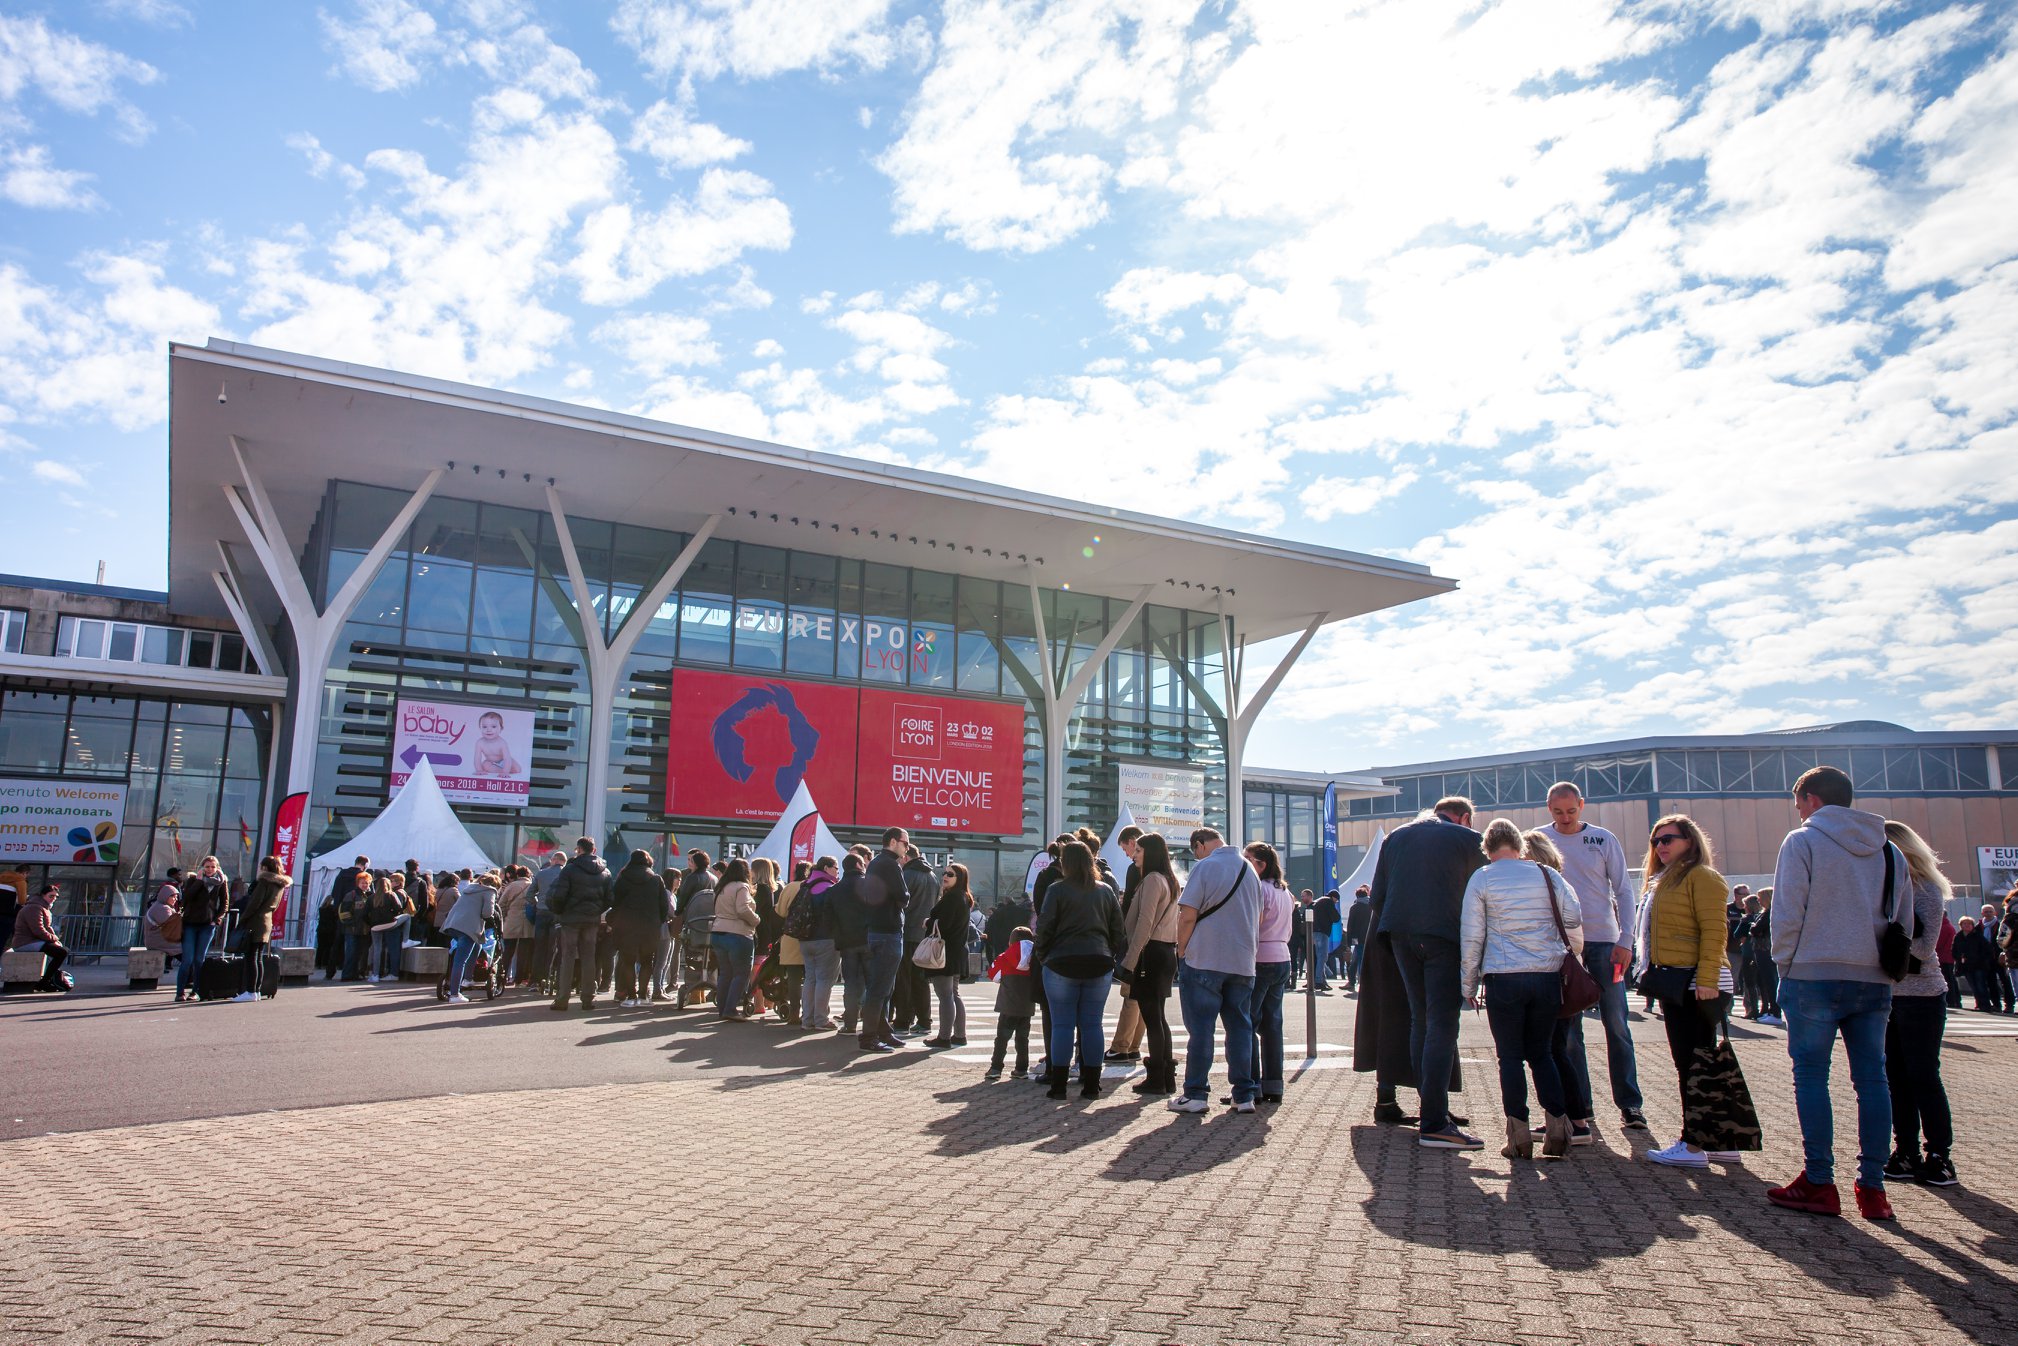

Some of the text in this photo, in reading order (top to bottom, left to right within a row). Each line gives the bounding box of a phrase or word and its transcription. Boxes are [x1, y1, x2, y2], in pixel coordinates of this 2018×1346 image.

[740, 606, 905, 649] EUREXPO
[865, 647, 928, 673] LYON
[408, 705, 435, 715] LE SALON
[404, 713, 466, 745] baby
[901, 718, 934, 732] FOIRE
[947, 722, 993, 736] 23 02
[900, 732, 934, 746] LYON
[892, 764, 993, 789] BIENVENUE
[1121, 767, 1150, 779] Welkom
[457, 779, 477, 789] 2018
[486, 781, 502, 791] Hall
[504, 782, 515, 792] 2.1
[518, 783, 524, 792] C
[55, 787, 120, 800] Welcome
[891, 785, 993, 809] WELCOME
[24, 806, 113, 817] пожаловать
[1164, 805, 1200, 816] Bienvenido
[1583, 835, 1605, 846] RAW
[1992, 859, 2017, 867] NOUV
